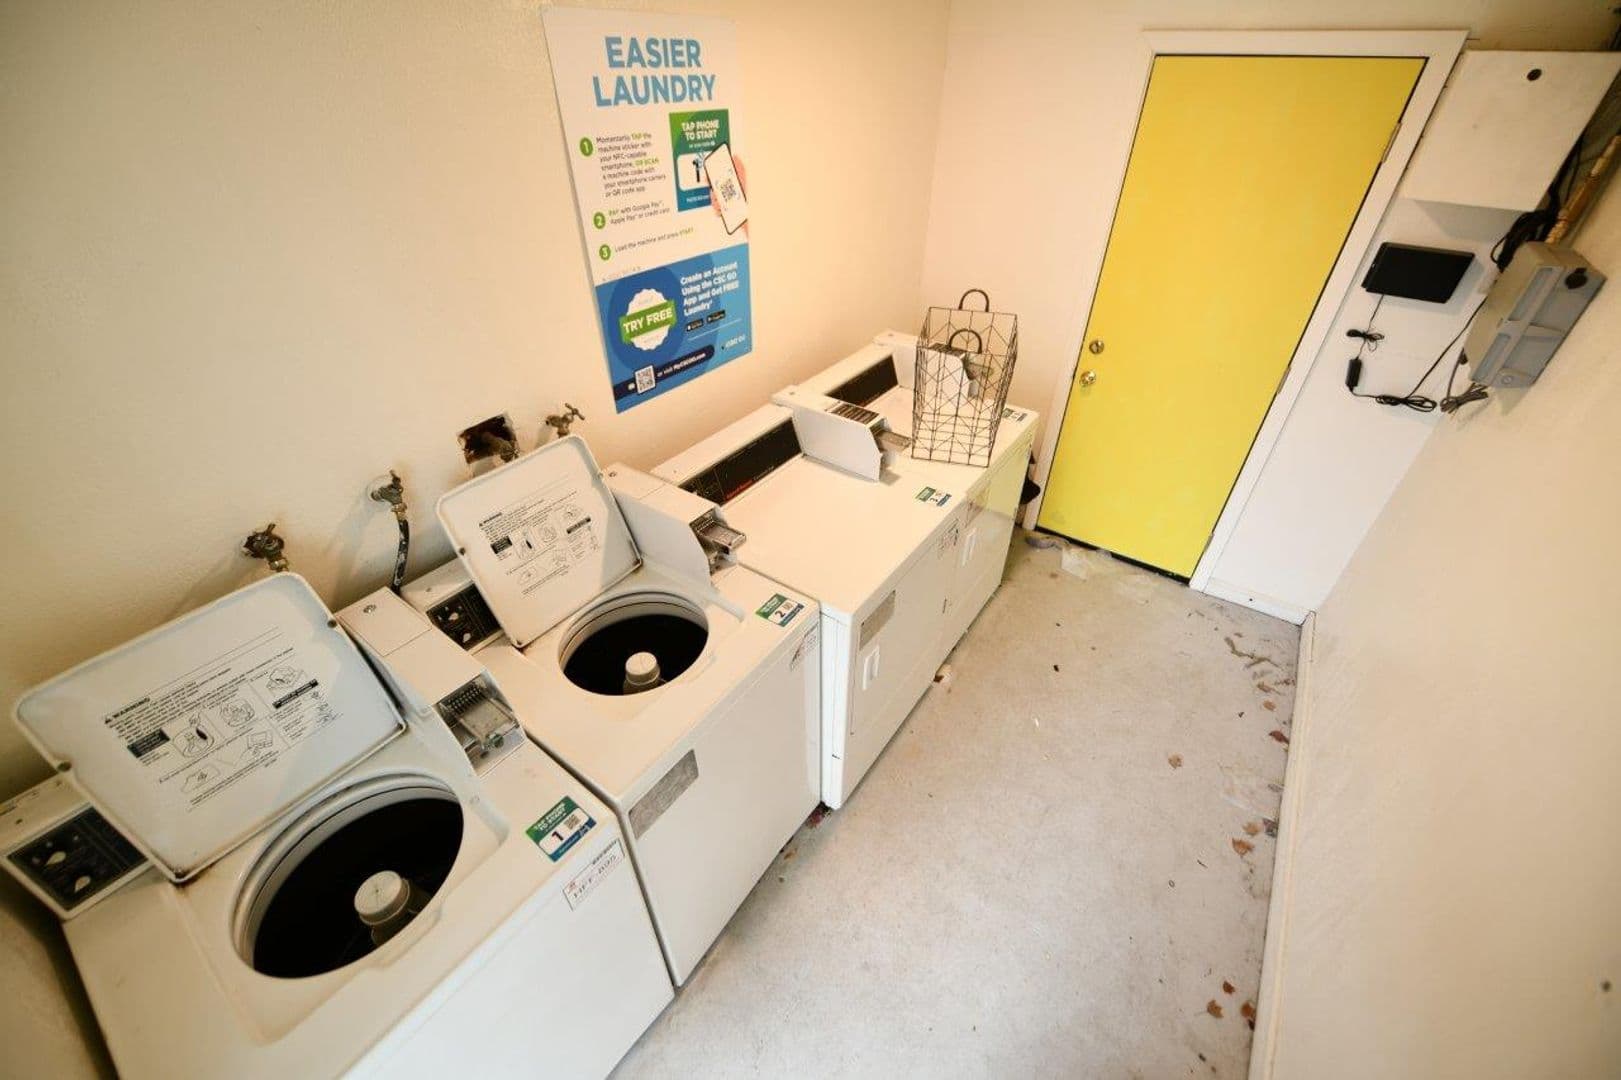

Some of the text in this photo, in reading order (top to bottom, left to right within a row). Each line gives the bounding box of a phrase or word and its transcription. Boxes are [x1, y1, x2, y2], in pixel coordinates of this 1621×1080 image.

[605, 36, 702, 68] EASIER
[593, 74, 716, 107] LAUNDRY
[681, 120, 720, 131] TAP PHONE
[685, 129, 717, 140] TO START
[598, 145, 621, 153] machine
[600, 155, 612, 163] your
[607, 171, 629, 179] machine
[604, 174, 667, 190] your smartphone camera
[612, 189, 621, 197] QR
[632, 203, 650, 211] Google
[611, 217, 625, 225] Apple
[637, 237, 657, 246] machine
[680, 261, 738, 285] Create an Account
[681, 285, 701, 297] Using
[702, 280, 712, 289] the
[713, 275, 726, 285] CSC
[684, 280, 739, 306] App and Get FREE
[623, 317, 645, 333] TRY
[646, 307, 673, 326] FREE
[551, 831, 564, 841] 1
